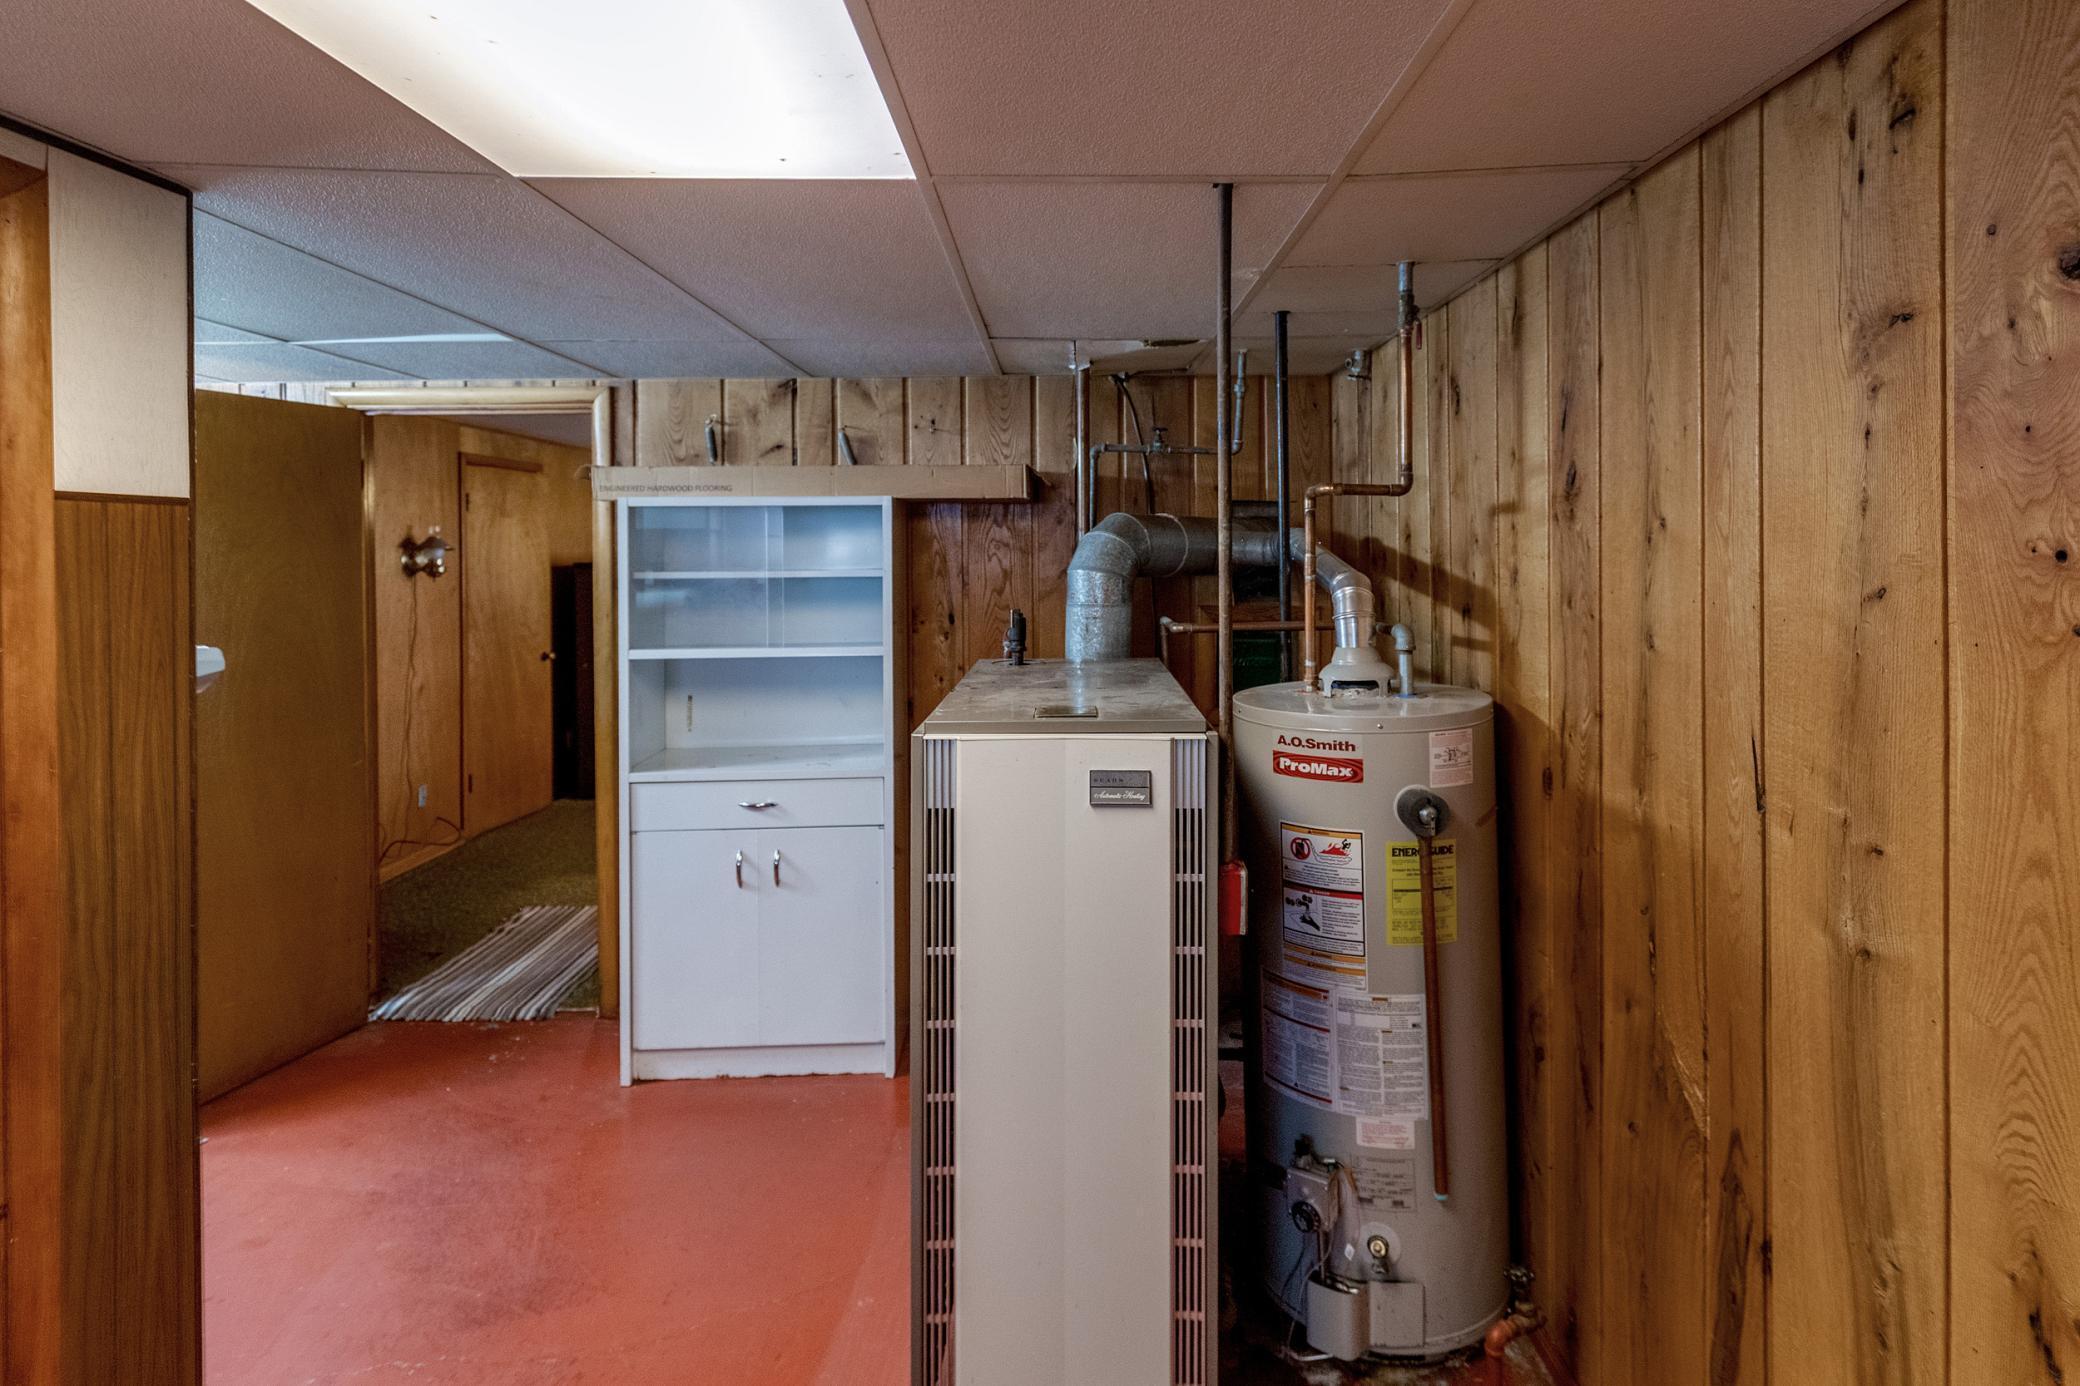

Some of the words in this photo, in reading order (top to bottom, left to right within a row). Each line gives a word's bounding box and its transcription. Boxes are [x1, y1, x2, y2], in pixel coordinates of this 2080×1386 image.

[647, 484, 693, 492] HARDWOOD
[695, 484, 733, 492] FLOORING
[1279, 757, 1352, 777] ProMax
